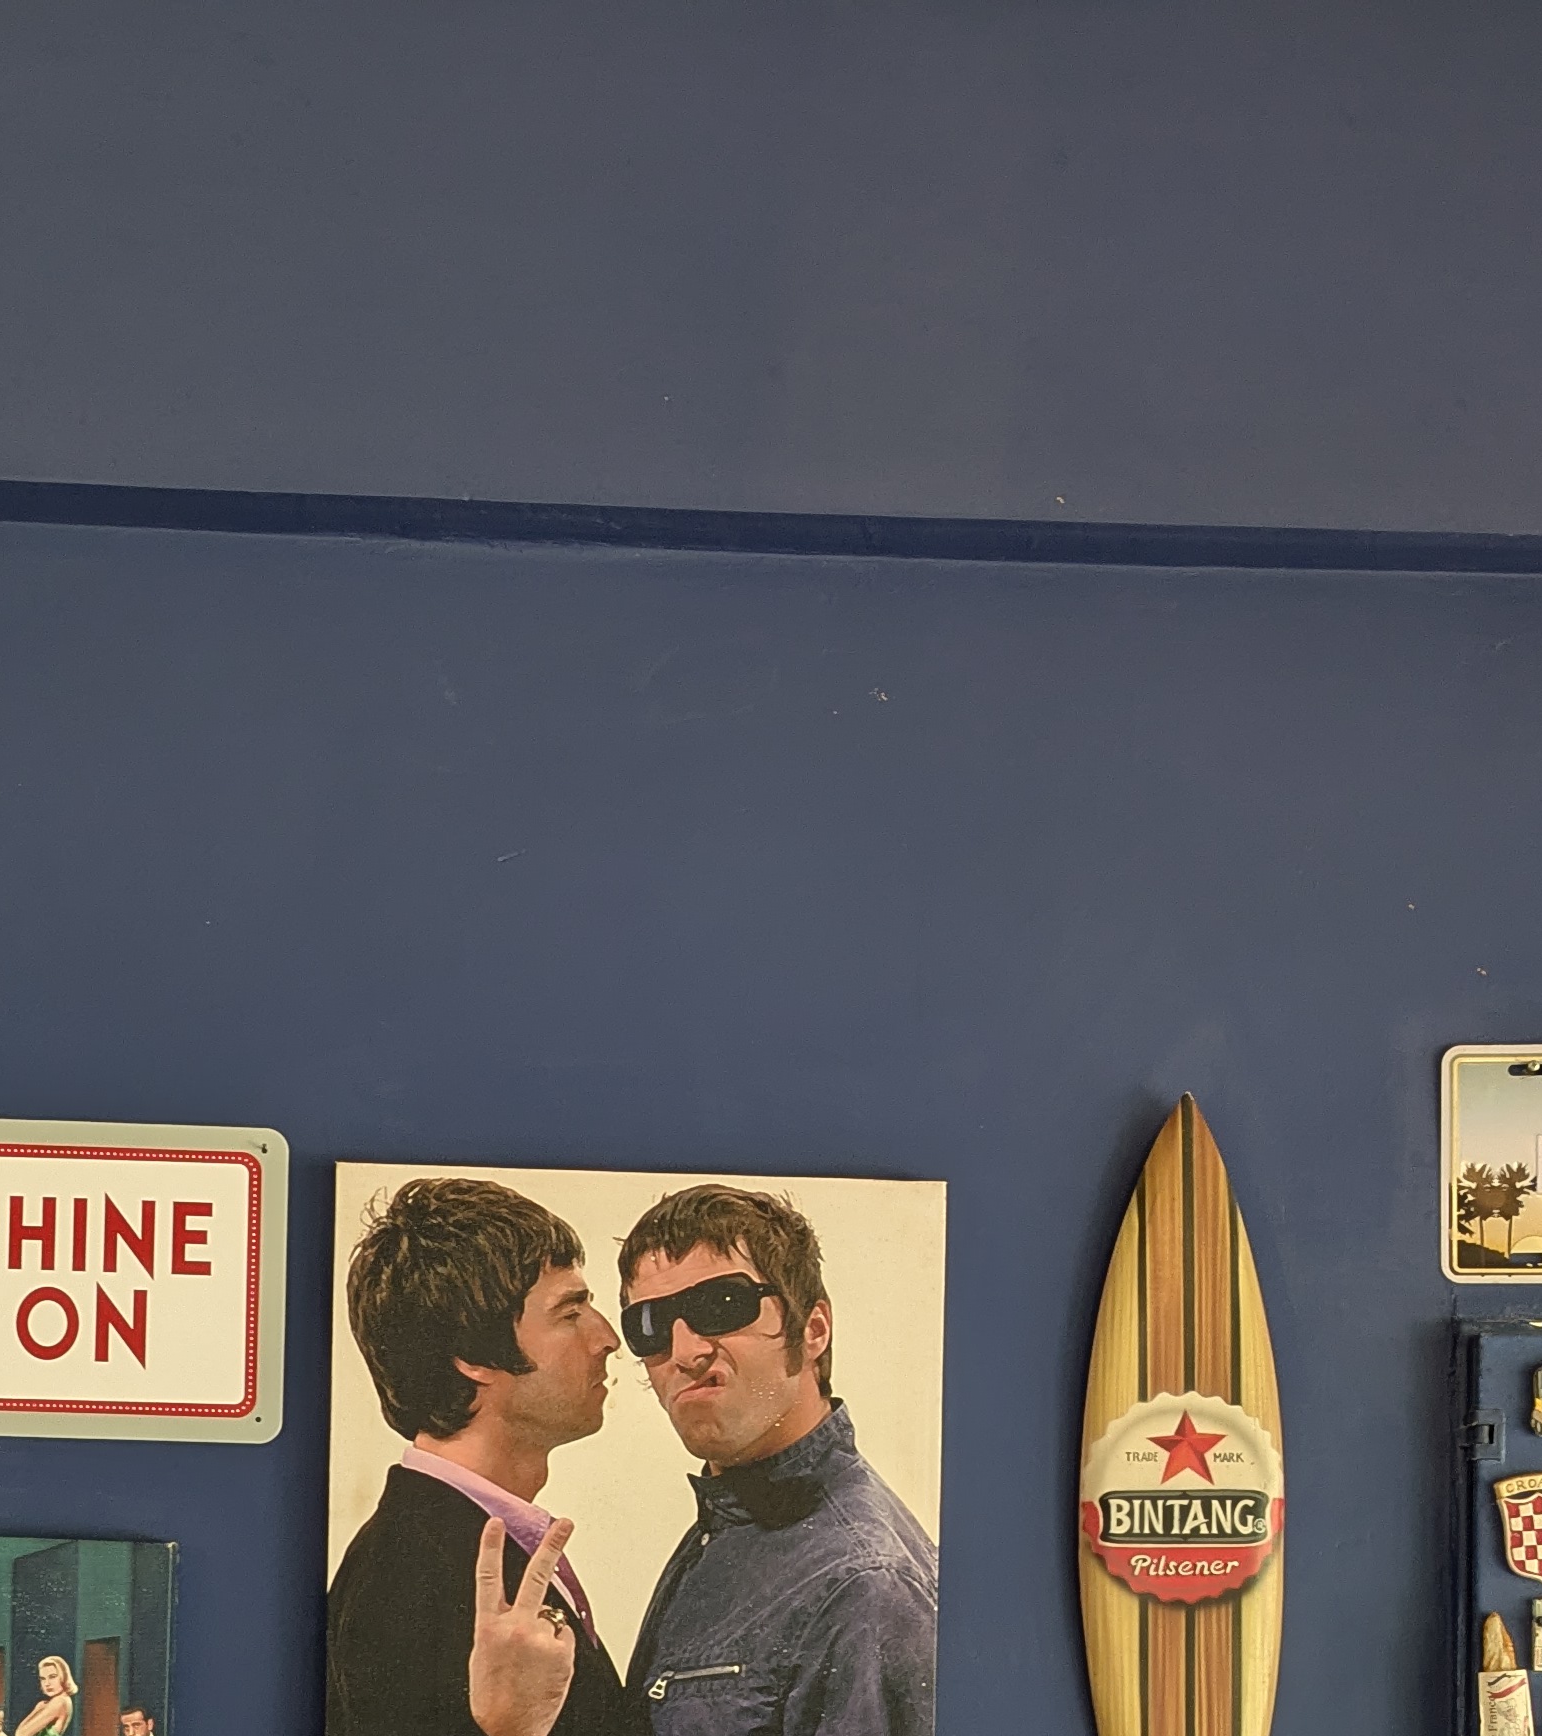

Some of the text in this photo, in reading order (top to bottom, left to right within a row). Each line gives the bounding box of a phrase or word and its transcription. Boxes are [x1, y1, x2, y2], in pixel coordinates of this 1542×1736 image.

[15, 1281, 149, 1370] ON
[1125, 1450, 1245, 1464] TRADE MARK
[1130, 1553, 1240, 1578] Pilsener
